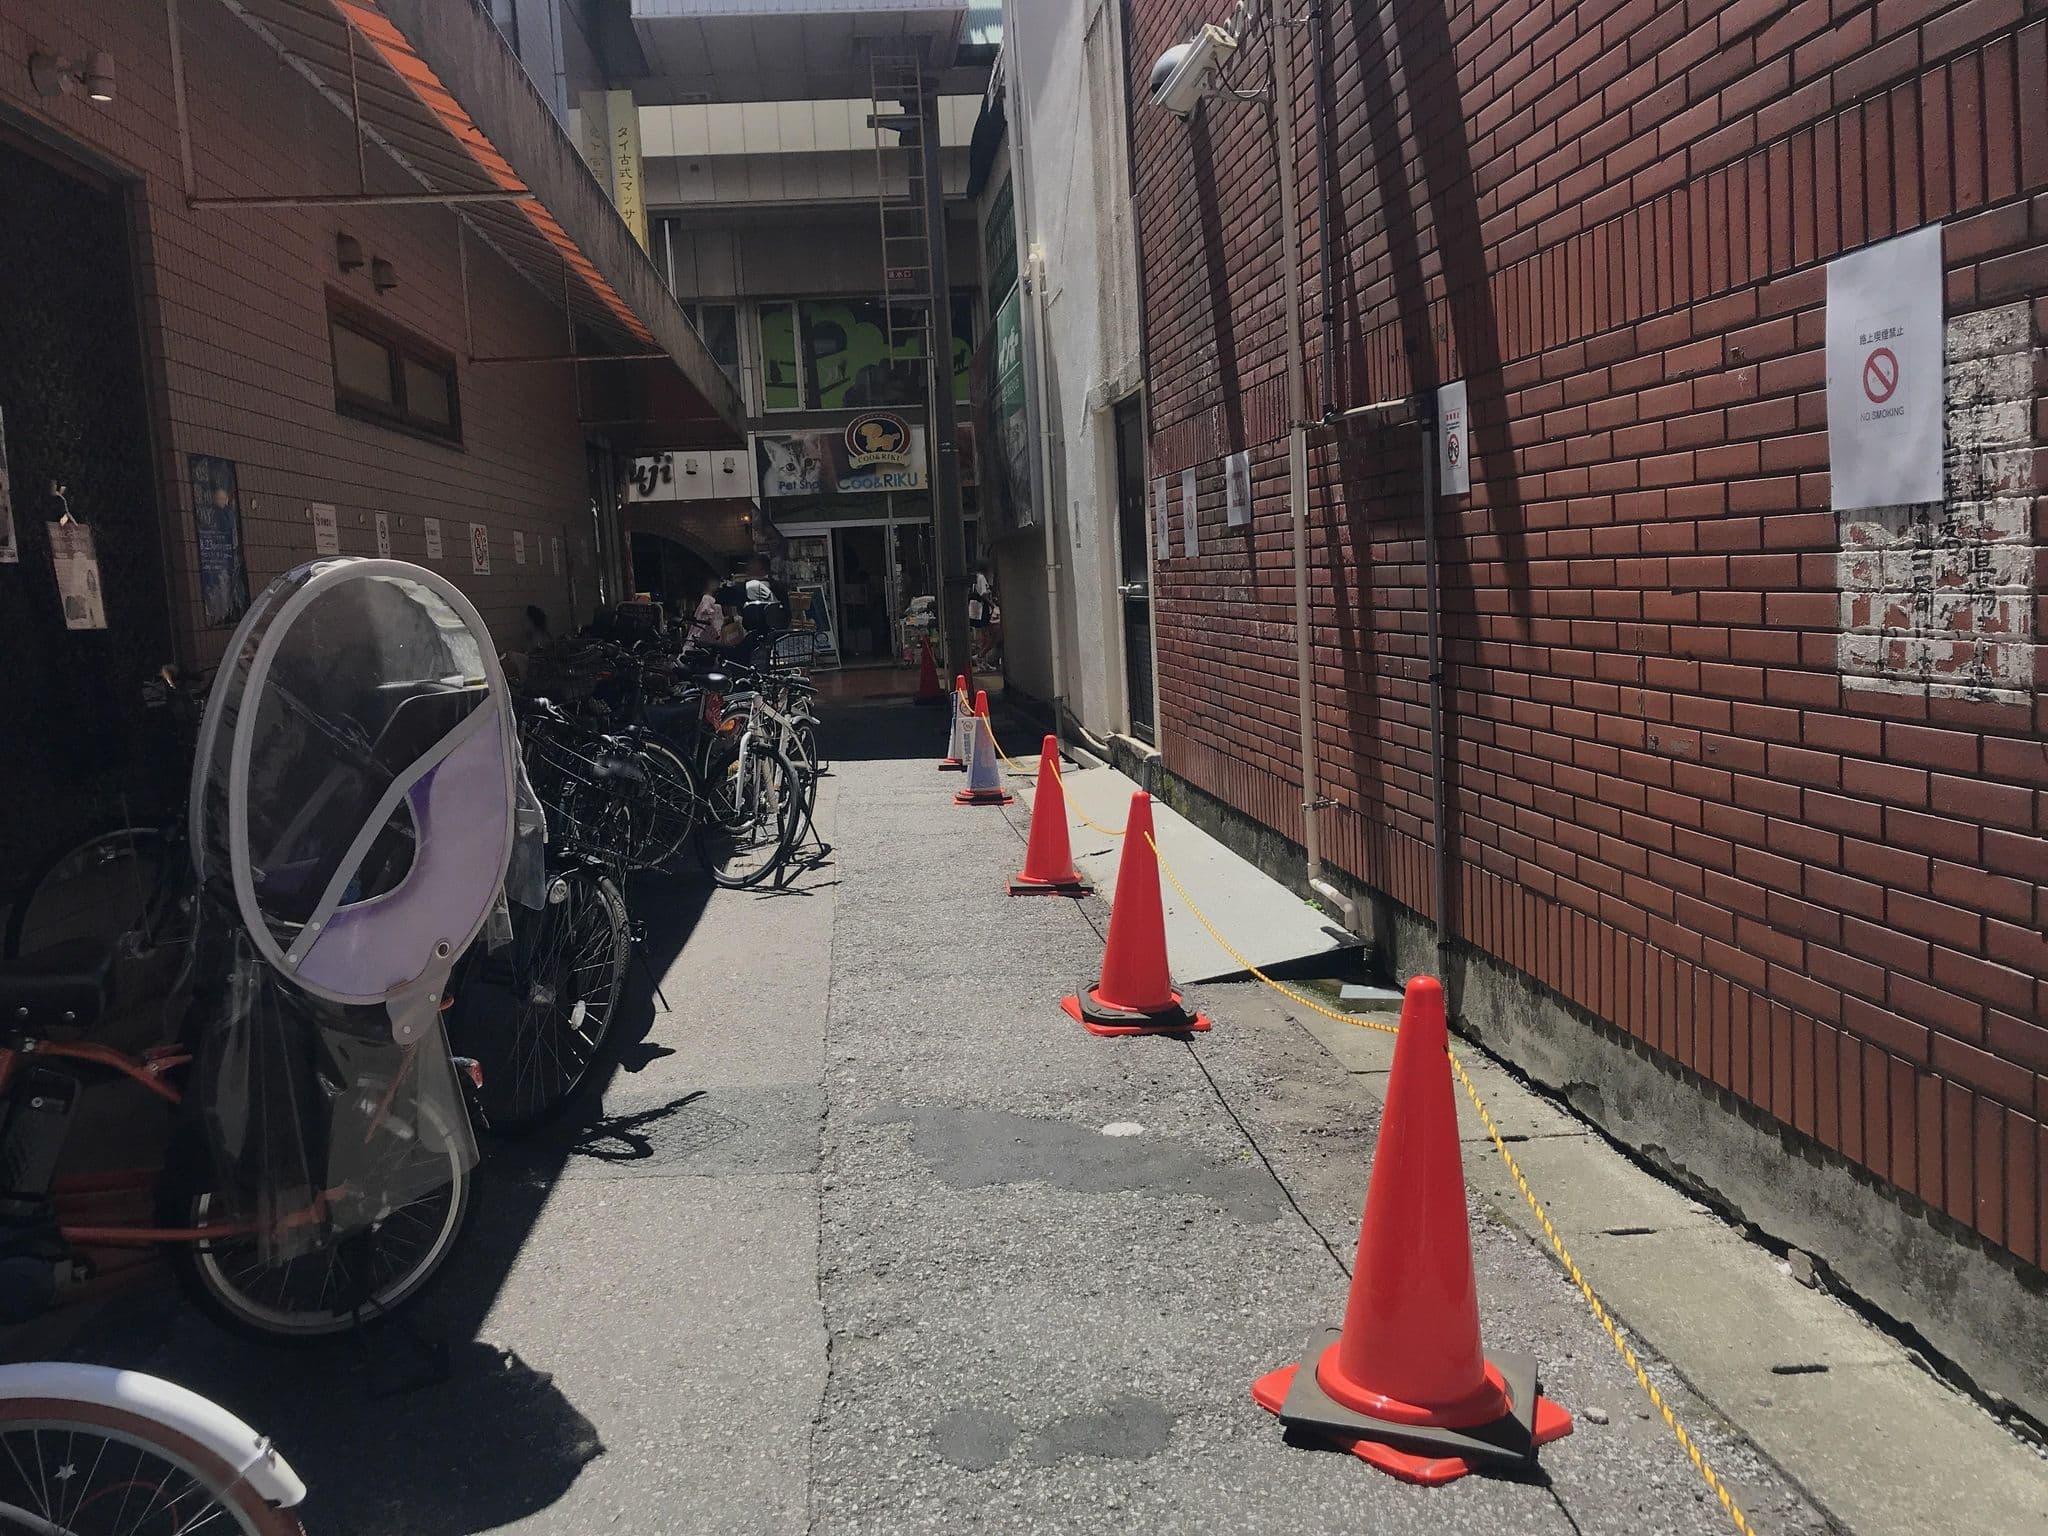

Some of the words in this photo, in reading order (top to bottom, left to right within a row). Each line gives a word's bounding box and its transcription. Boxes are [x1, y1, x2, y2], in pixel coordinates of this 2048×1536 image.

[1860, 411, 1871, 422] NO
[1872, 405, 1905, 421] SMOKING
[778, 480, 797, 491] Pet
